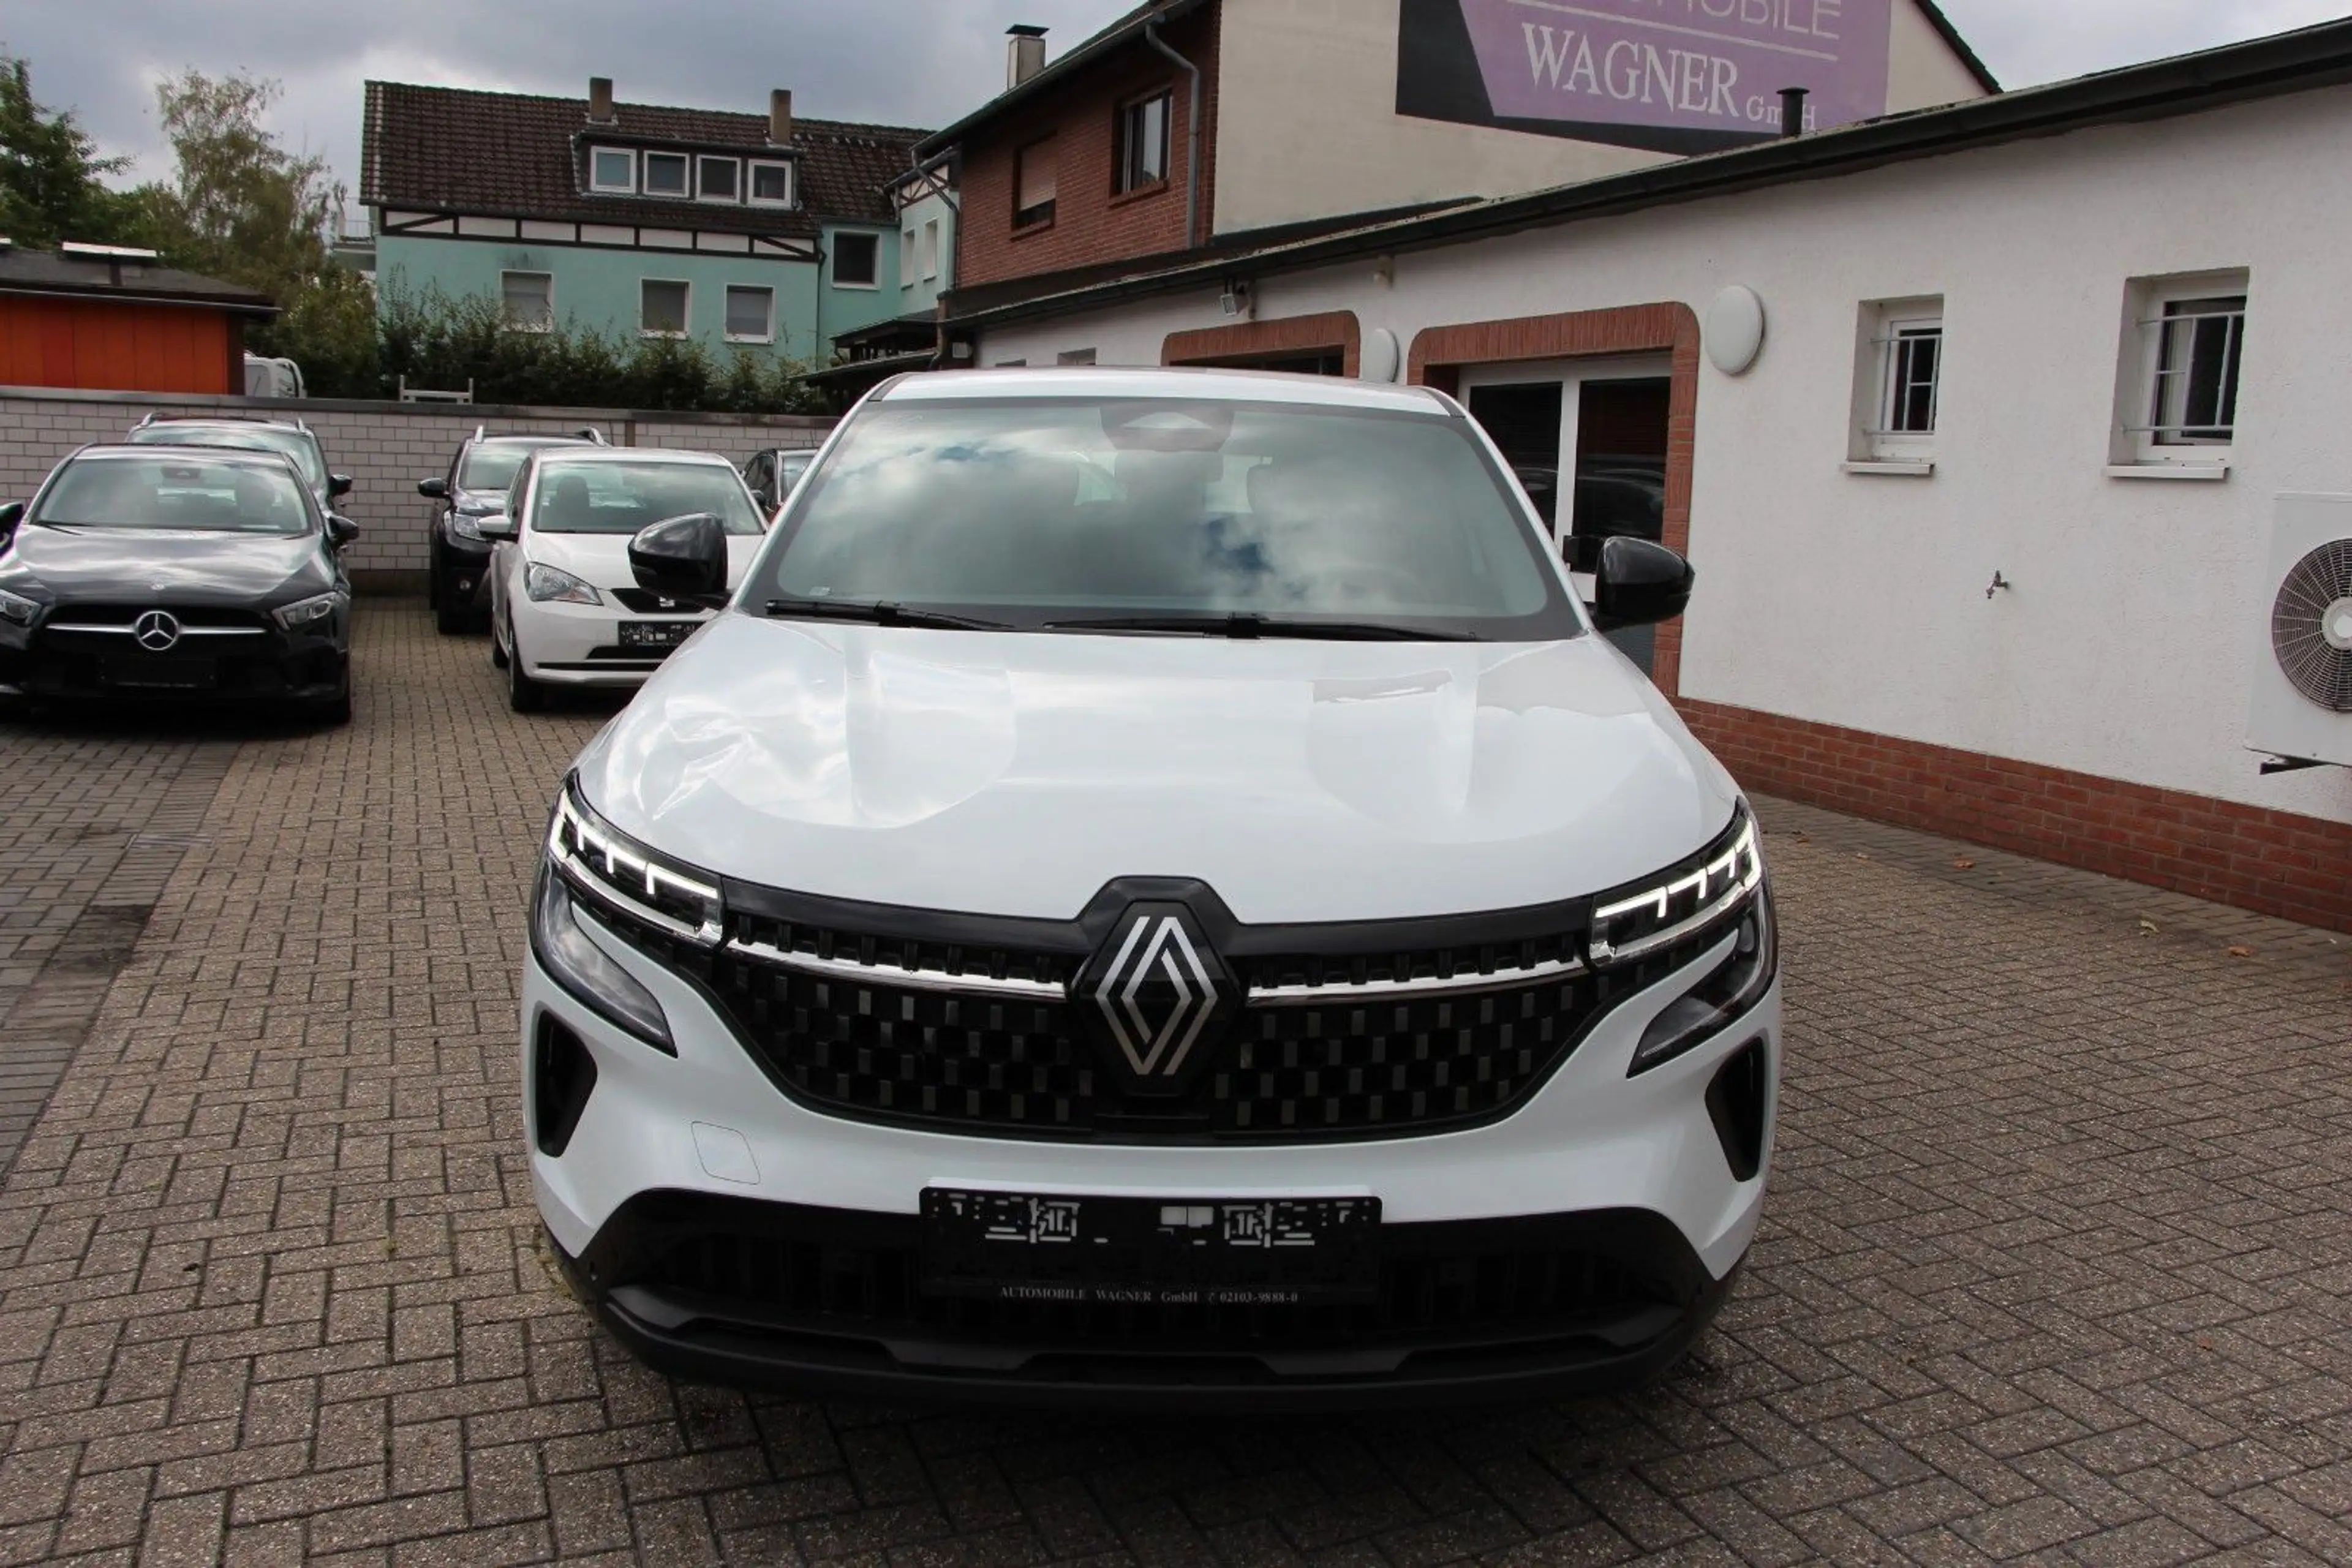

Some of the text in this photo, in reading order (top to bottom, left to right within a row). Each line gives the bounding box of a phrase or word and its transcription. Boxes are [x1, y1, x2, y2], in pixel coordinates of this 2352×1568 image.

[1520, 21, 1816, 131] WAGNER GmH
[1000, 1286, 1087, 1300] AUTOMOBILE
[1096, 1289, 1152, 1302] WAGNER
[1161, 1291, 1198, 1303] GmbH
